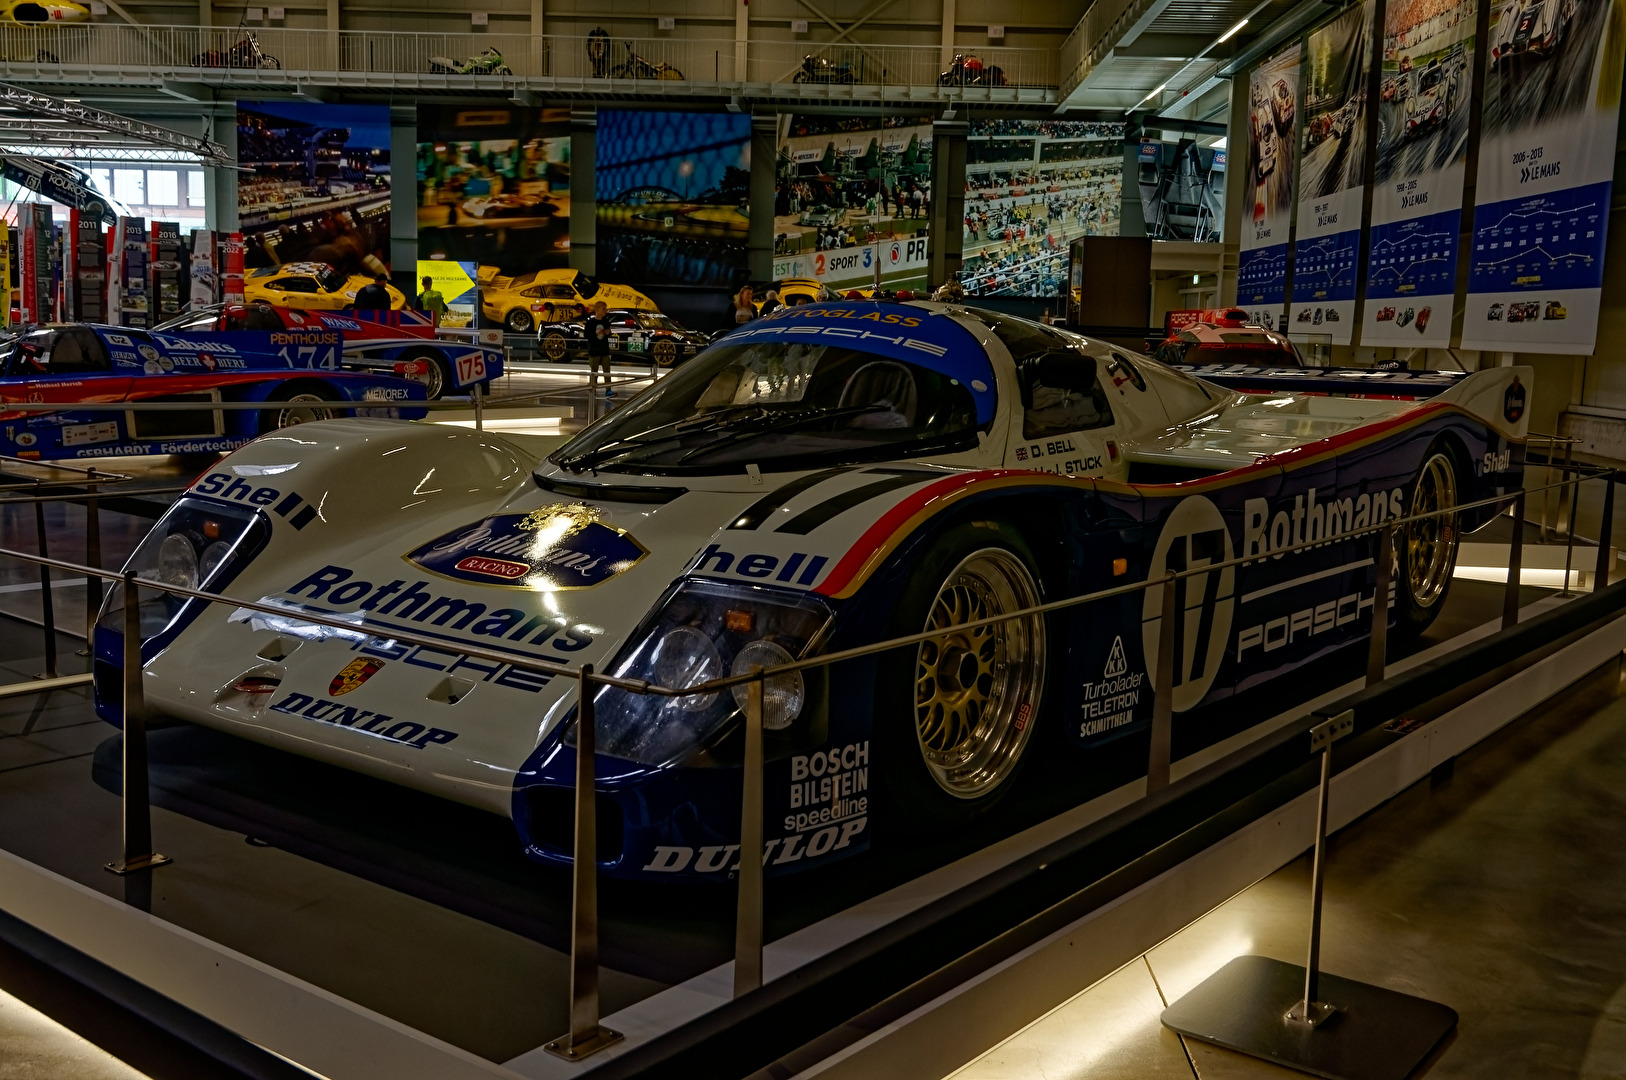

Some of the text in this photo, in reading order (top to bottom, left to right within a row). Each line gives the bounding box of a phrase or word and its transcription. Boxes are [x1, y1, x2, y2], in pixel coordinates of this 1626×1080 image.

[1520, 20, 1528, 31] 2
[1512, 151, 1526, 165] 2006
[1530, 147, 1543, 160] 2013
[1531, 161, 1560, 181] LE MANS
[48, 173, 87, 198] KOUROS
[1408, 192, 1428, 207] LE MANS
[78, 221, 97, 229] 2011
[126, 226, 143, 235] 2013
[158, 231, 177, 239] 2016
[222, 246, 240, 254] 2022
[815, 249, 872, 273] 2 SPORT 3
[773, 262, 790, 276] EST
[321, 317, 361, 330] WANG
[559, 309, 574, 319] 315
[270, 333, 339, 345] PENTHOUSE
[630, 342, 643, 351] 23
[171, 357, 202, 367] BEER
[277, 346, 339, 371] 174
[459, 355, 484, 381] 175
[367, 389, 409, 400] MEMOREX
[76, 444, 151, 457] GERHARDT
[1030, 440, 1076, 458] D. BELL
[1065, 455, 1102, 474] STUCK
[1482, 450, 1510, 473] Shell
[195, 473, 319, 531] Shell
[1242, 487, 1403, 567] Rothmans
[465, 559, 518, 576] RACING
[682, 544, 829, 586] hell
[286, 565, 603, 652] Rothmans
[1166, 529, 1224, 688] 17
[1236, 580, 1397, 663] PORSCHE
[1083, 671, 1144, 700] Turbolader
[1081, 689, 1139, 719] TELETRON
[269, 693, 459, 750] DUNLOP
[1014, 703, 1030, 731] BBS
[1080, 709, 1133, 738] SCHMITTHELM
[791, 740, 869, 782] BOSCH
[790, 767, 868, 809] BILSTEIN
[784, 796, 868, 832] speedline
[642, 817, 868, 873] DUNLOP
